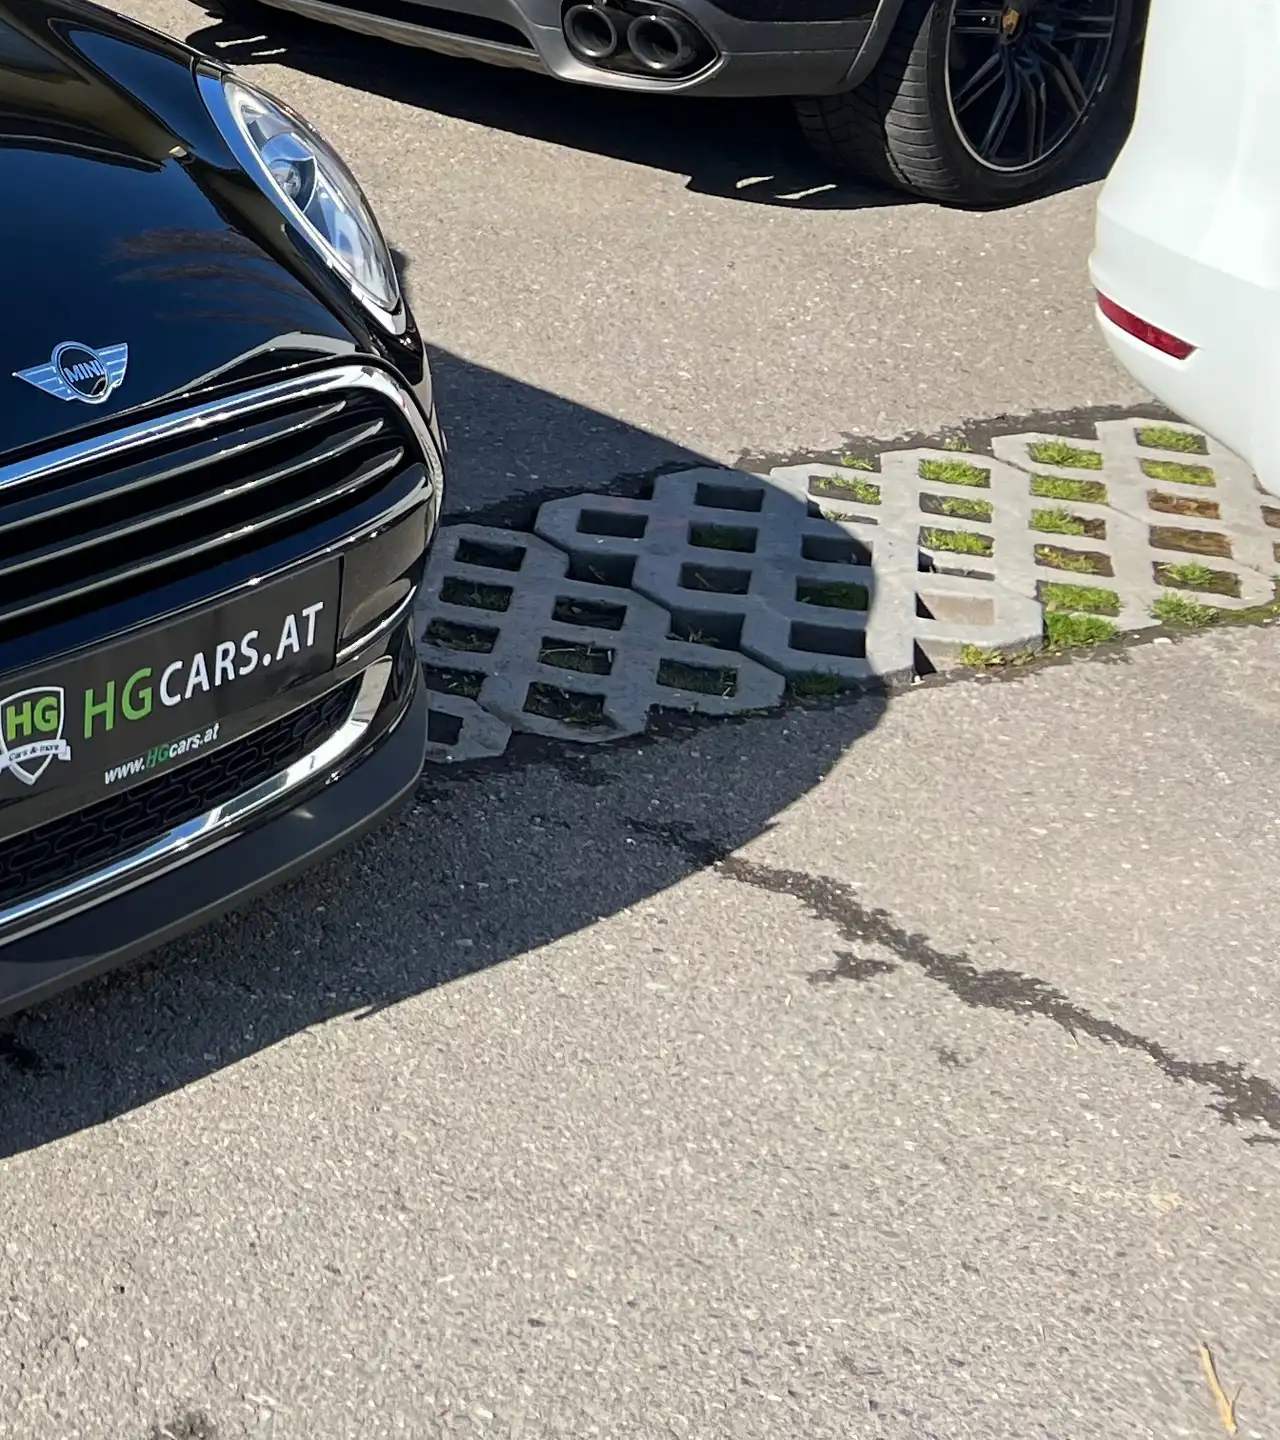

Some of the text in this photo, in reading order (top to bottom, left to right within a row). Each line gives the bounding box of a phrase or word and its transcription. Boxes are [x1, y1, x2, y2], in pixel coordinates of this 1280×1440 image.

[64, 359, 105, 383] MINI
[83, 601, 325, 739] HGCARS.AT
[5, 695, 59, 742] HG
[104, 722, 220, 785] www.HGcars.at
